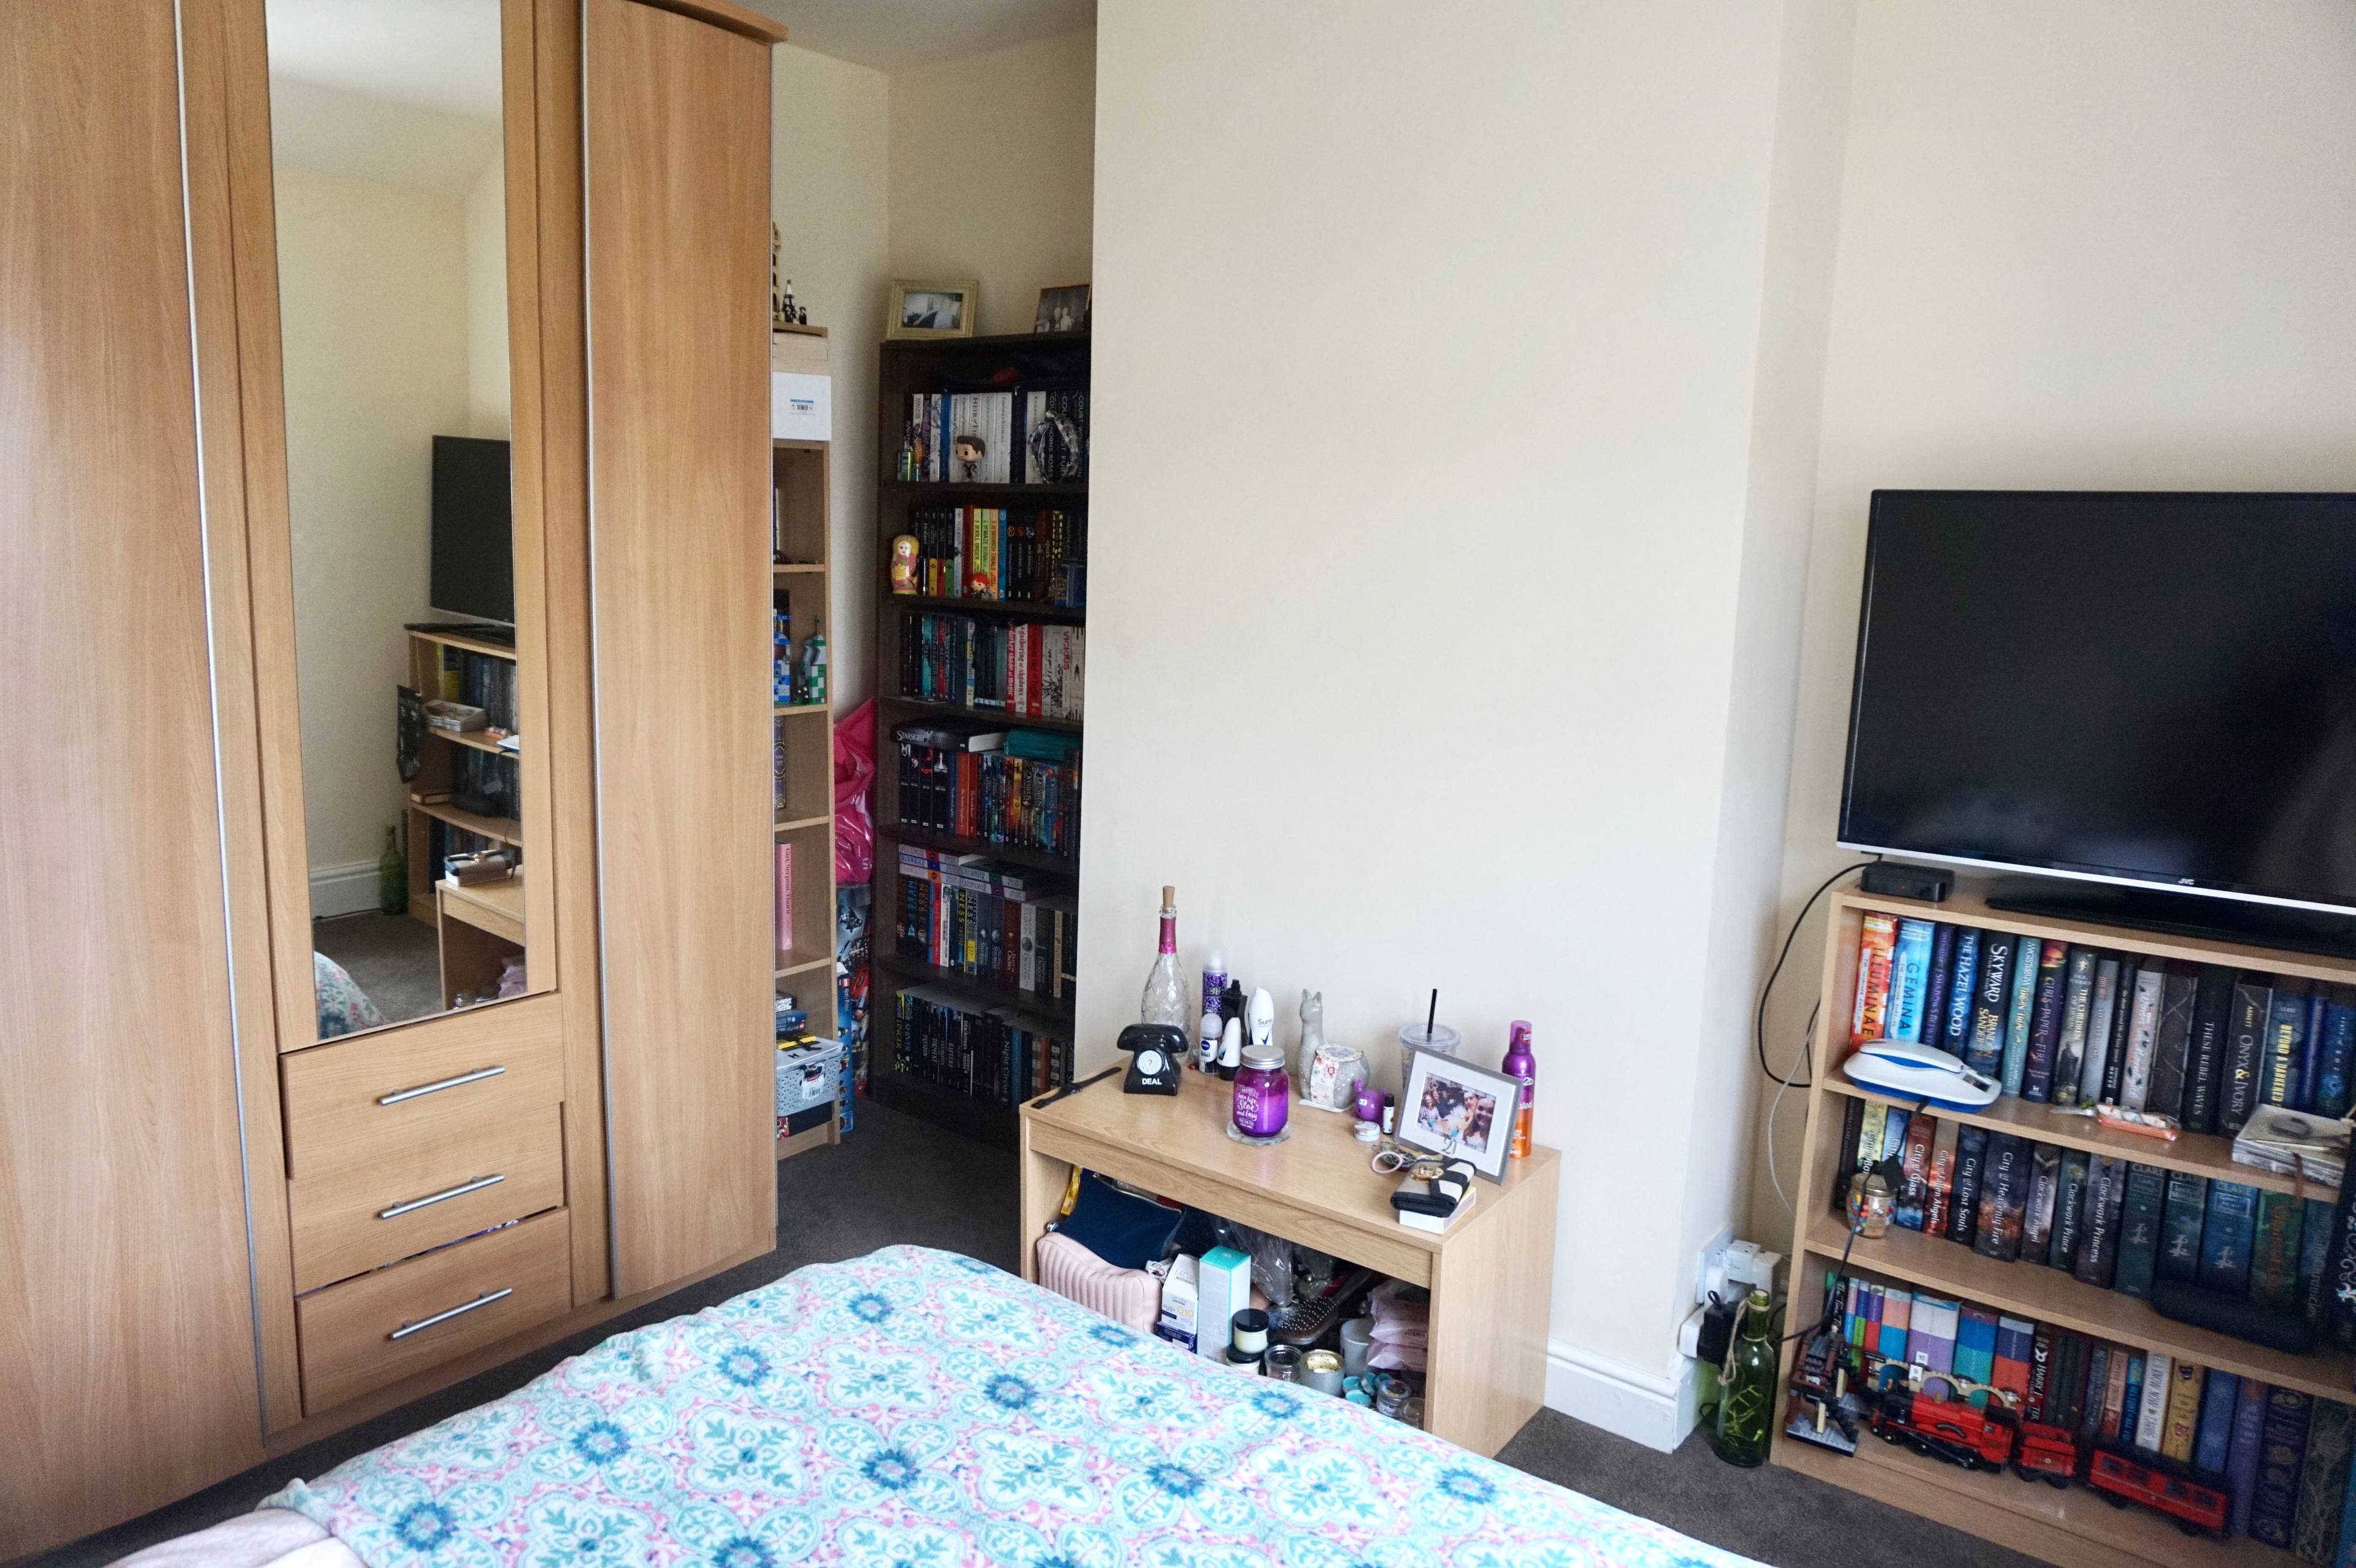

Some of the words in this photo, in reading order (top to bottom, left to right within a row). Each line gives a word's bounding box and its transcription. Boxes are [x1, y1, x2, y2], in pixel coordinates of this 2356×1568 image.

[1966, 935, 1975, 954] THE
[1955, 956, 1973, 993] HAZEL
[1984, 943, 2008, 1002] SKYWARD
[2022, 941, 2036, 985] MAGISTERIUM
[1862, 947, 1884, 1036] ILLUMINAE
[1899, 963, 1919, 1030] GEMINA
[2041, 977, 2055, 1003] GIRLS
[2080, 988, 2088, 1002] THE
[1926, 1015, 1938, 1043] BETWEE
[1950, 996, 1966, 1037] WOOD
[2015, 1012, 2027, 1031] TRIAL
[2035, 1008, 2051, 1038] PAPER
[2073, 1004, 2087, 1040] CHILDREN
[2244, 1005, 2253, 1028] ABNETT
[2201, 1021, 2215, 1051] THESE
[2276, 1024, 2293, 1055] BEYOND
[2032, 1043, 2047, 1064] FIRE
[2236, 1034, 2254, 1068] ONYX
[2198, 1054, 2210, 1082] REBEL
[2234, 1068, 2250, 1080] &
[2271, 1063, 2289, 1102] DARKENED
[1237, 1099, 1259, 1112] Sloe
[2193, 1085, 2206, 1115] WAVES
[2230, 1081, 2249, 1115] IVORY
[1443, 1135, 1457, 1158] 21
[1865, 1131, 1877, 1149] City
[1887, 1139, 1901, 1156] City
[1911, 1143, 1925, 1163] City
[1937, 1150, 1949, 1166] City
[1962, 1158, 1977, 1176] City
[1998, 1151, 2014, 1171] City
[1908, 1173, 1921, 1197] Glass
[1934, 1175, 1945, 1197] Fallen
[1963, 1178, 1972, 1186] of
[1960, 1187, 1973, 1206] Lost
[1992, 1182, 2010, 1225] Heavenly
[2033, 1175, 2048, 1218] Clockwork
[2063, 1183, 2079, 1226] Clockwork
[2094, 1177, 2111, 1226] Clockwork
[1930, 1197, 1942, 1224] Angels
[1957, 1207, 1970, 1232] Souls
[1991, 1227, 2003, 1245] Fire
[2029, 1219, 2040, 1243] Angel
[2061, 1227, 2074, 1253] Prince
[2089, 1226, 2105, 1263] Princess
[1836, 1280, 1846, 1296] The
[1177, 1305, 1195, 1318] Q10
[1834, 1296, 1844, 1316] Time
[2034, 1364, 2047, 1391] HARRY
